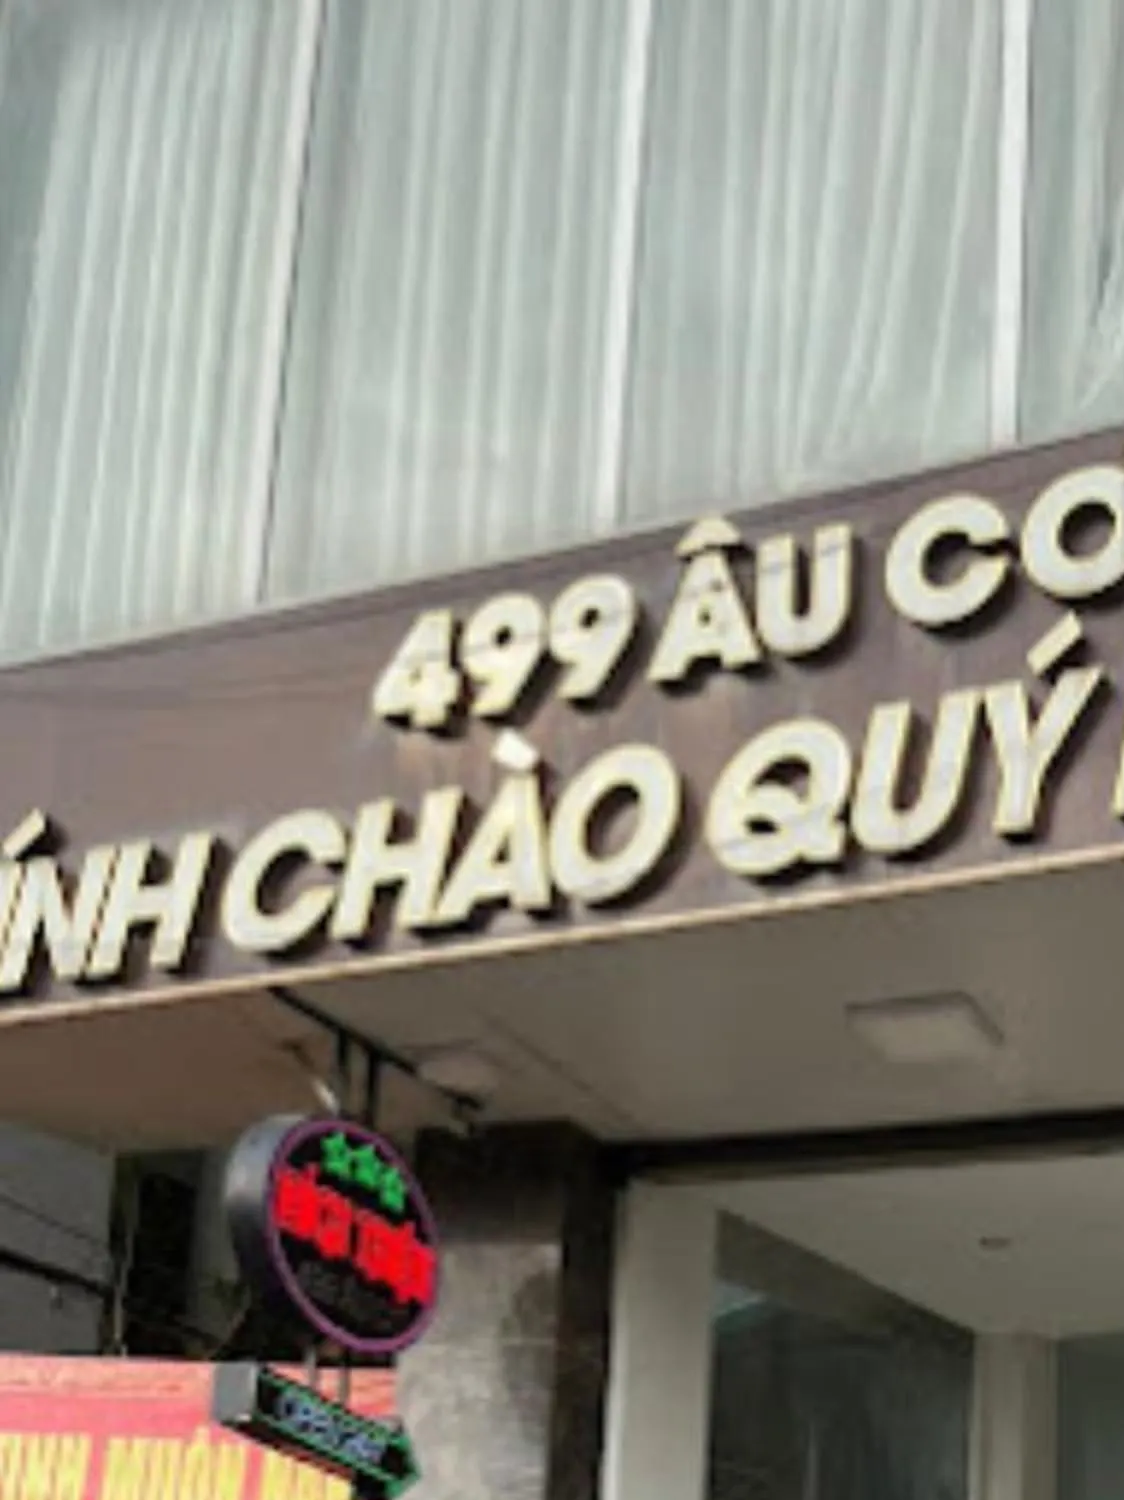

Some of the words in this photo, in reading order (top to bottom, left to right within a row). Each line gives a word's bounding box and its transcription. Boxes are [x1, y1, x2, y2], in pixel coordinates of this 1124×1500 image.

[371, 574, 634, 723] 499
[648, 516, 851, 681] ÂU
[221, 730, 678, 950] CHÀO
[706, 612, 1102, 873] QUÝ
